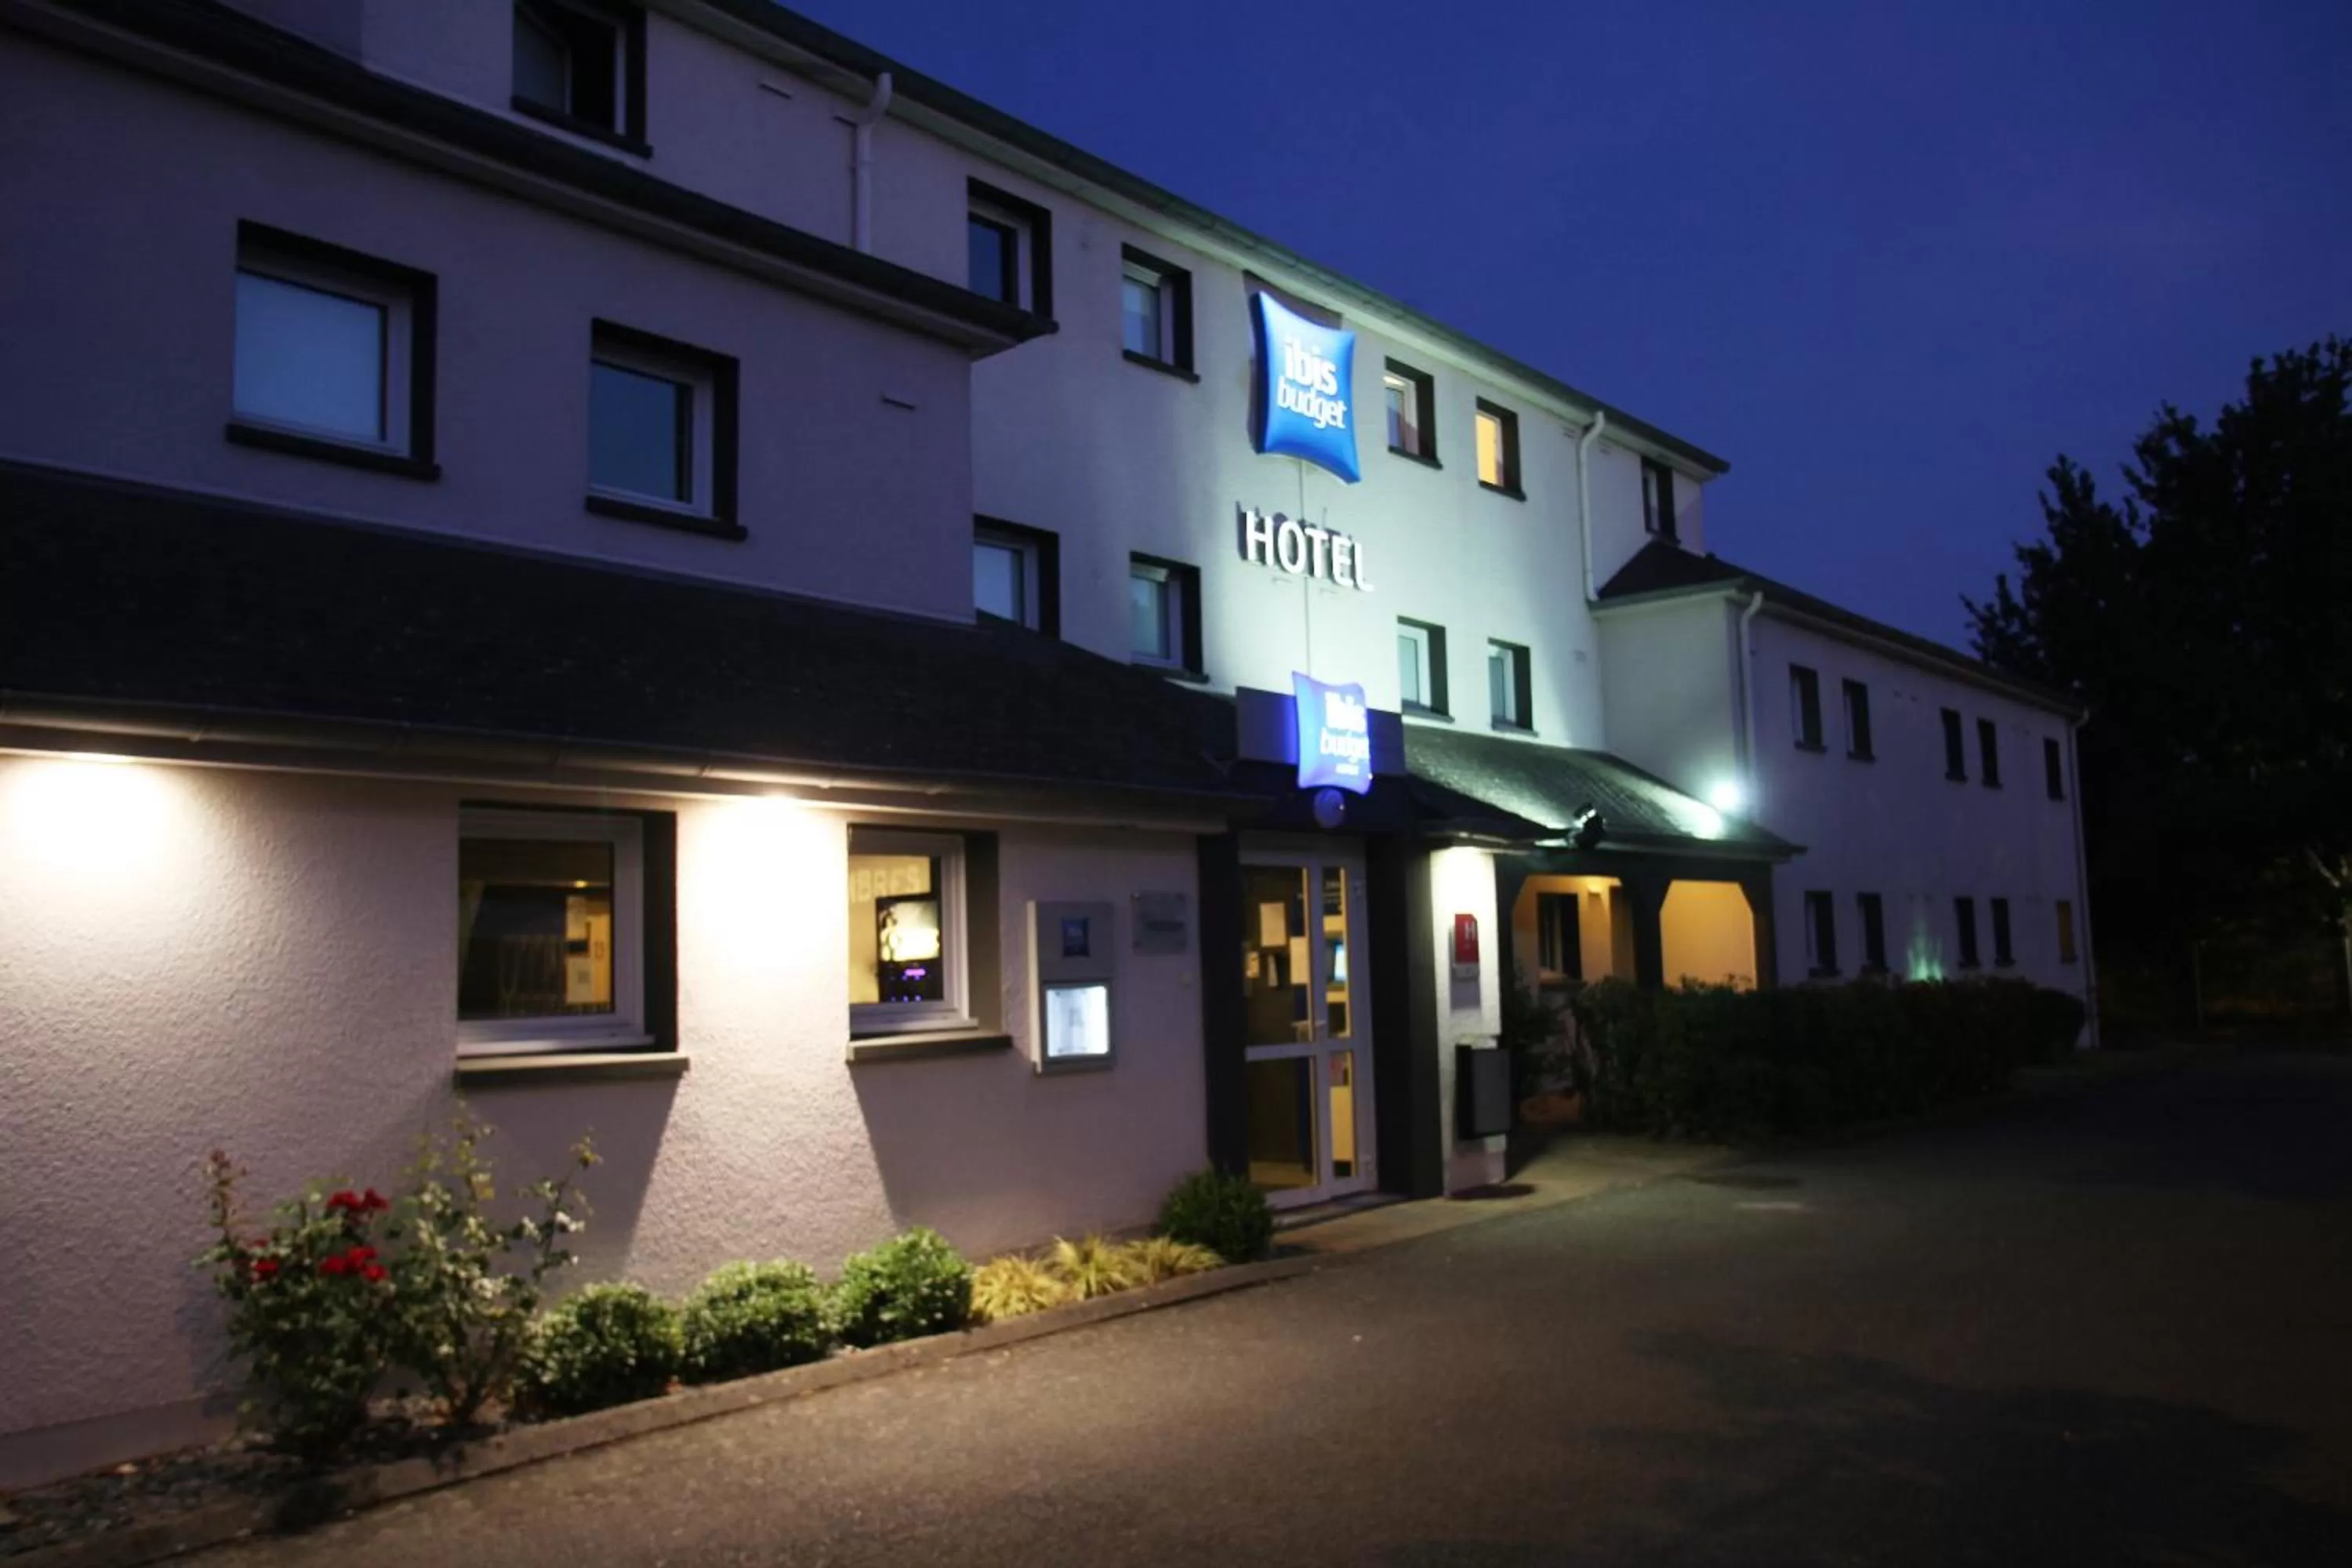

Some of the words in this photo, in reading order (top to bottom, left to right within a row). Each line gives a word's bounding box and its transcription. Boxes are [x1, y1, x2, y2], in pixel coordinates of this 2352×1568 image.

[1284, 339, 1338, 396] ibis
[1276, 375, 1348, 429] budget
[1245, 510, 1375, 593] HOTEL
